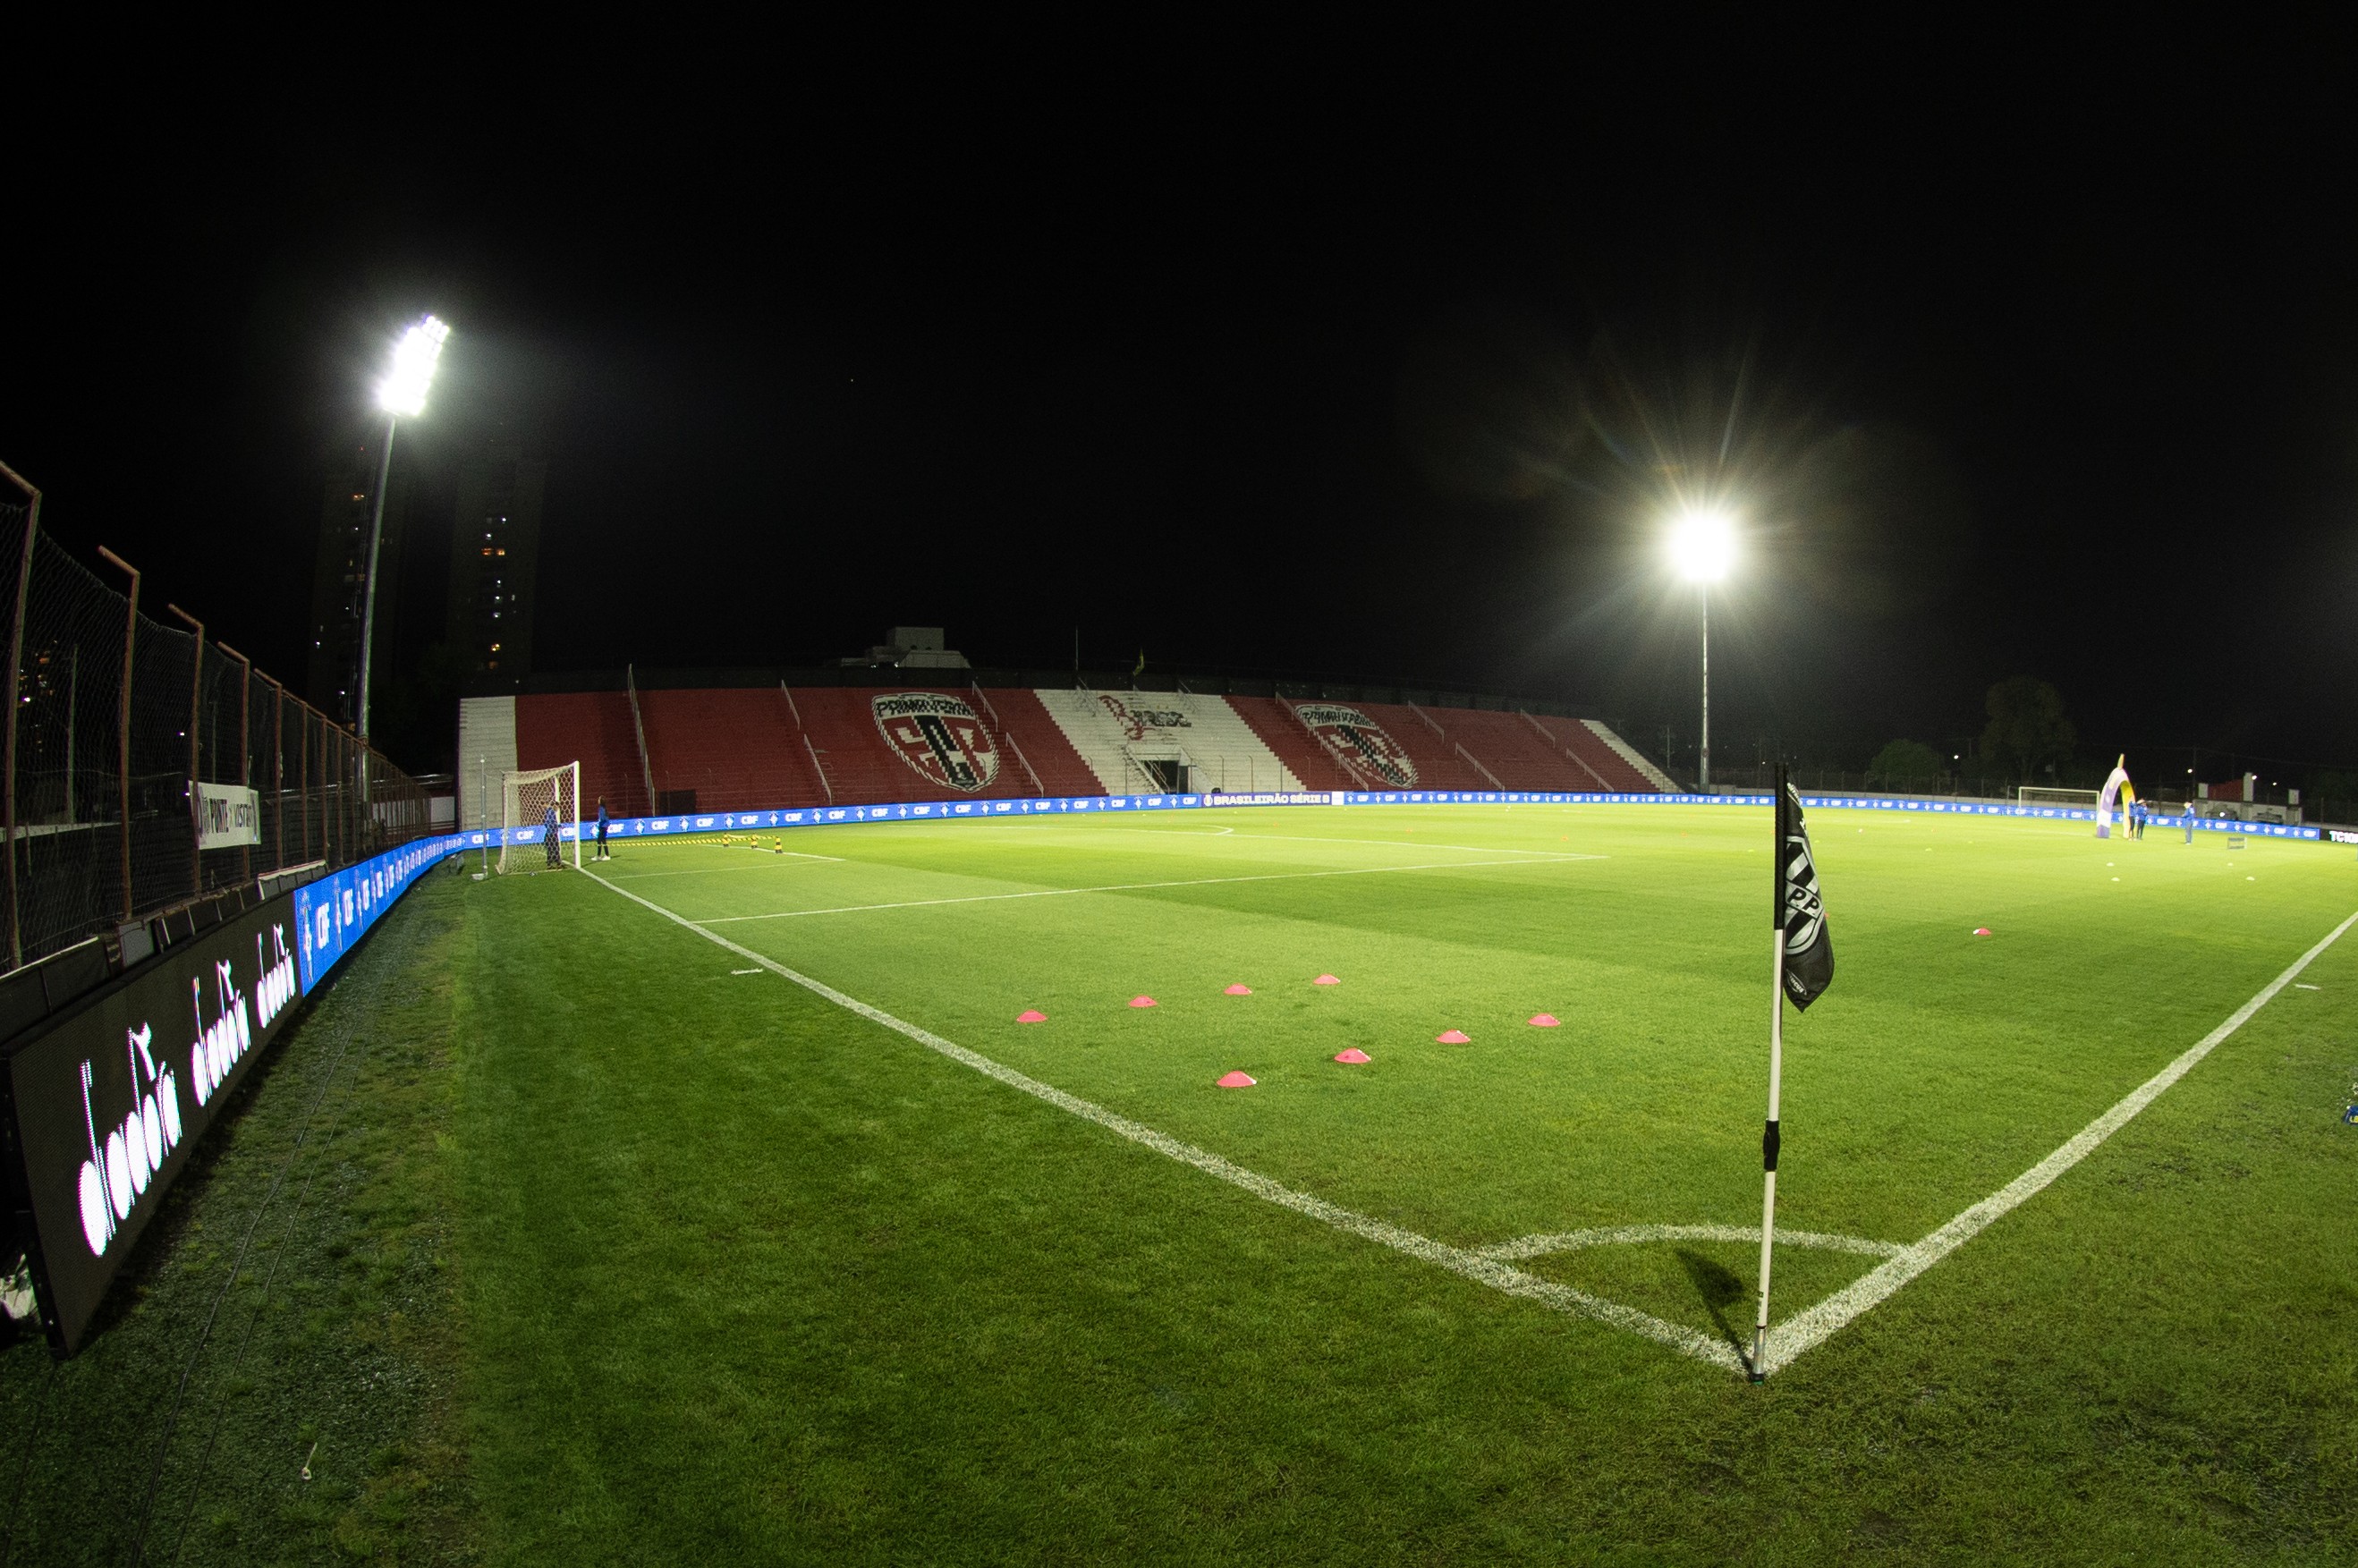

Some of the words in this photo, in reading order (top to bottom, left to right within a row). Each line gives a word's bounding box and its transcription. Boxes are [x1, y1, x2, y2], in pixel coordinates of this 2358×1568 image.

[1214, 792, 1288, 806] BRASILEIRÃO
[1290, 792, 1321, 804] SÉRIE
[79, 1025, 182, 1258] diadora
